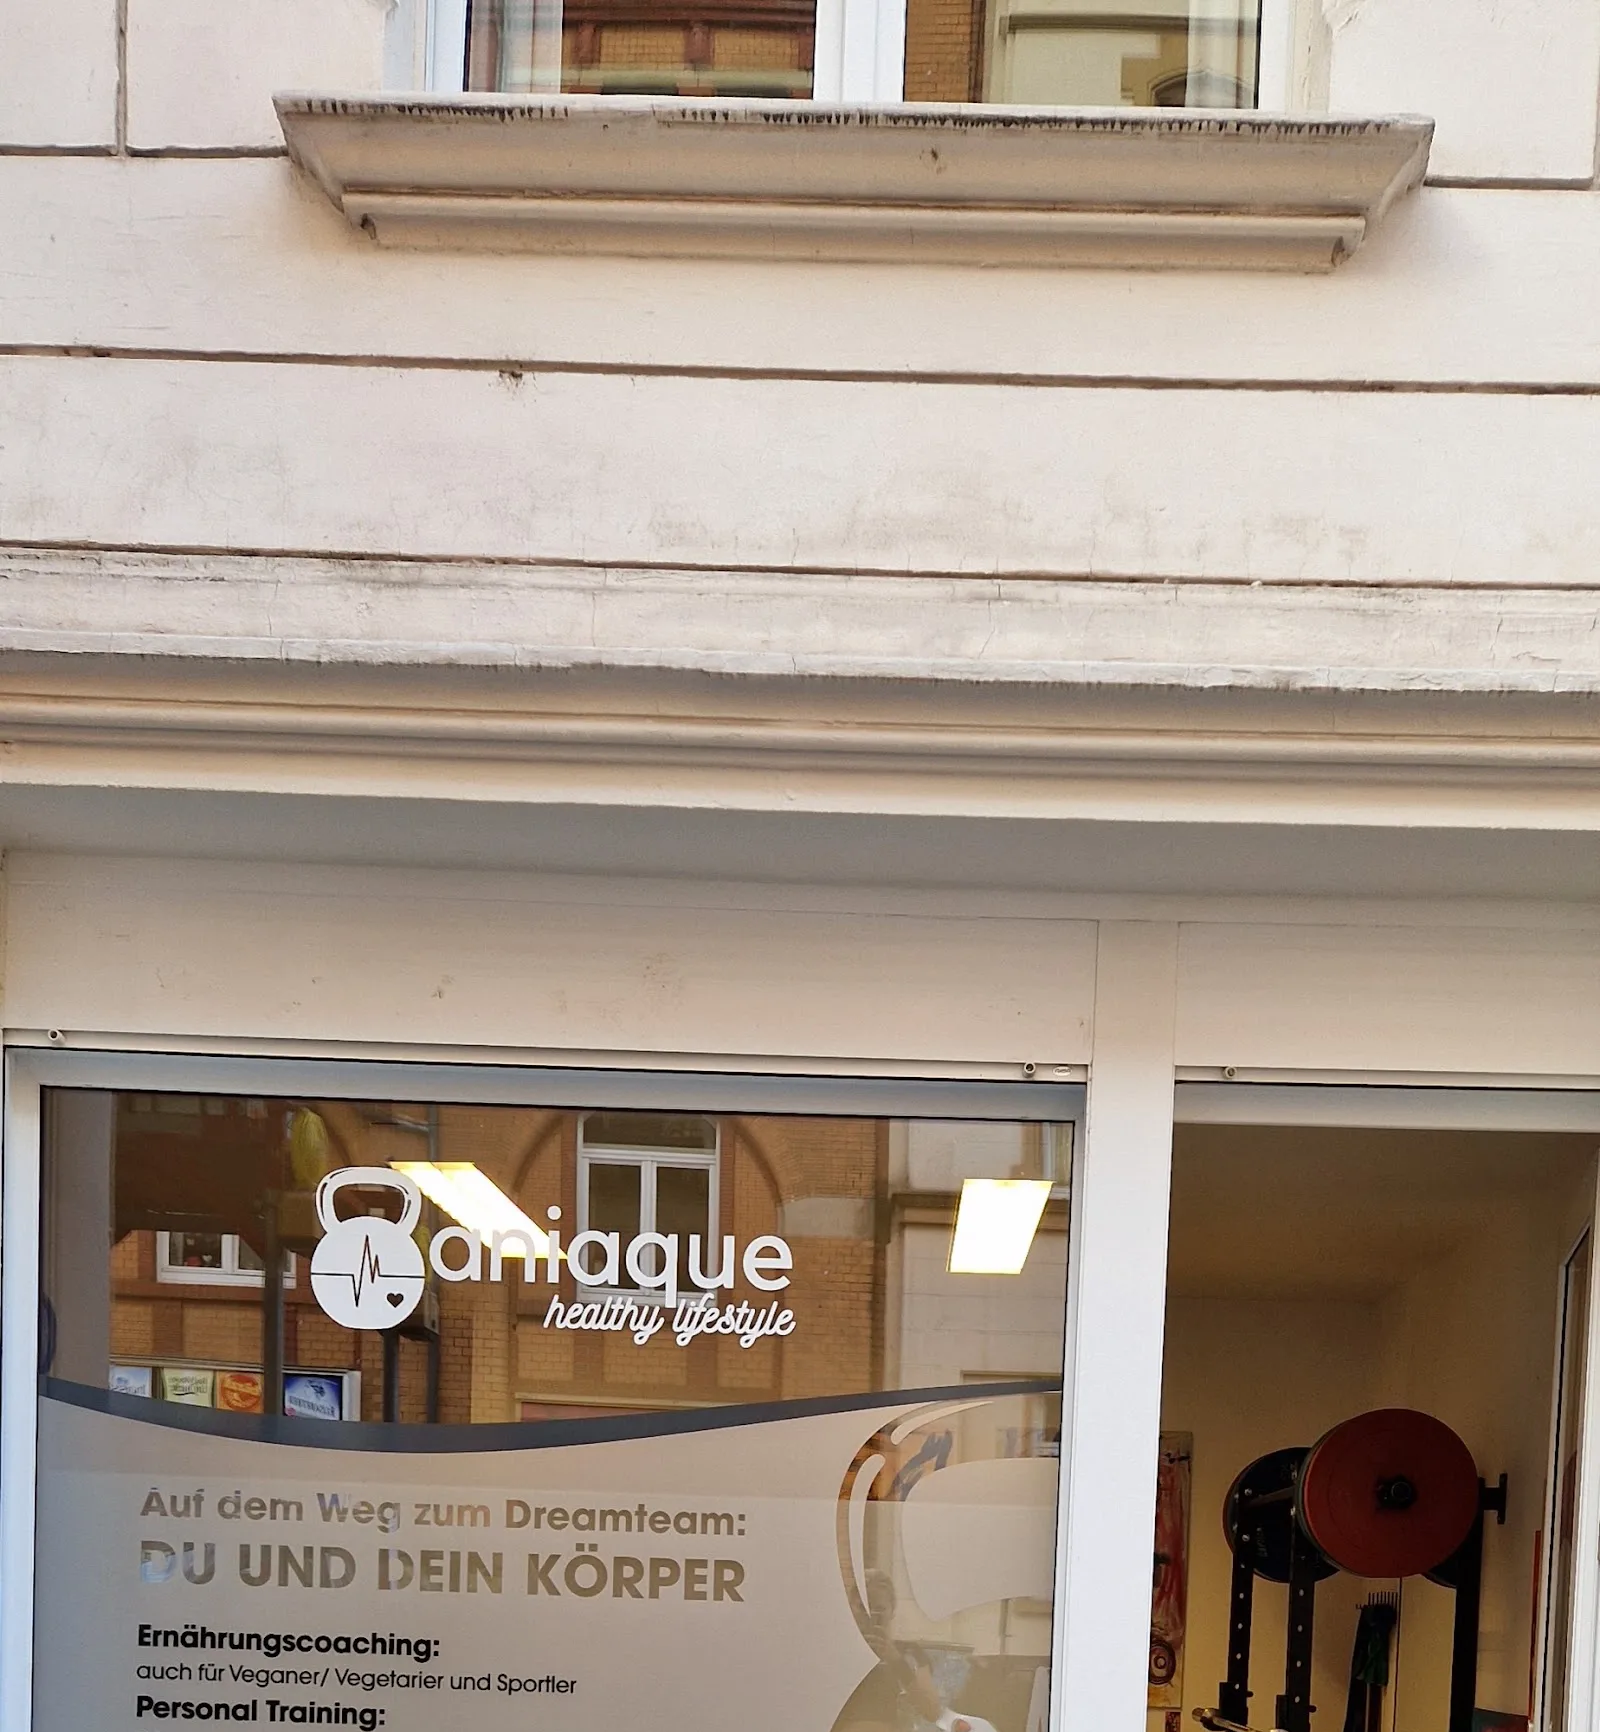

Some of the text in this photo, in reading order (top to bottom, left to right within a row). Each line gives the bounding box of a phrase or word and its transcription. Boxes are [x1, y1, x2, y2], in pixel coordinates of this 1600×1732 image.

[430, 1205, 793, 1307] aniaque
[543, 1293, 796, 1348] healthy lifestyle
[139, 1487, 745, 1536] Auf dem Weg zum Dreamteam:
[139, 1540, 745, 1602] DU UND DEIN KÖRPER
[137, 1624, 440, 1662] Ernährungscoaching:
[136, 1663, 577, 1695] auch für Veganer/ Vegetarier und Sportler
[136, 1695, 385, 1732] Personal Training:
